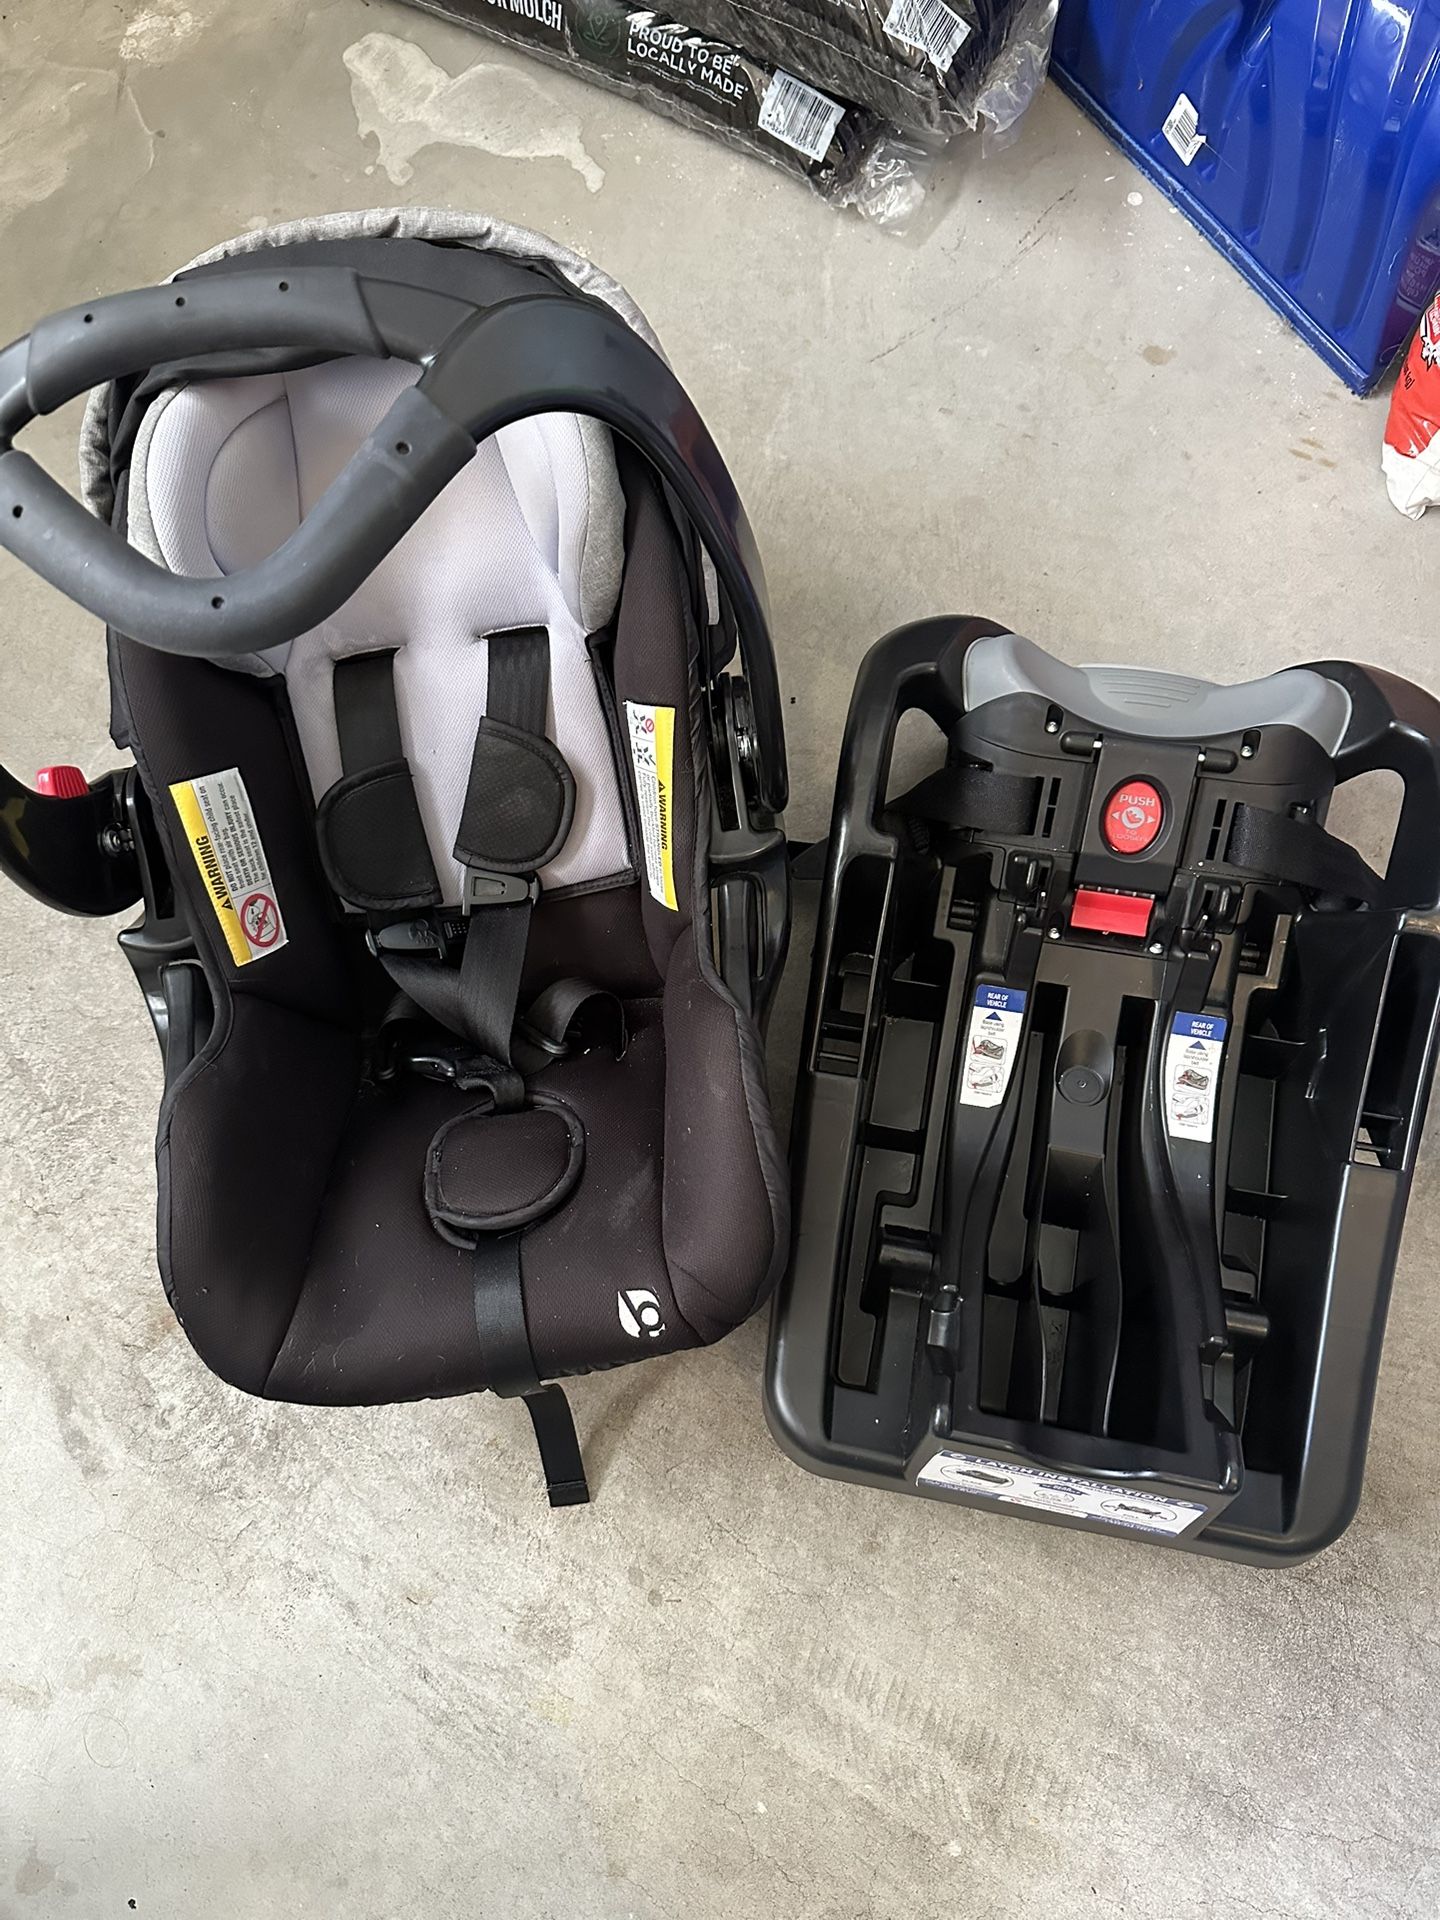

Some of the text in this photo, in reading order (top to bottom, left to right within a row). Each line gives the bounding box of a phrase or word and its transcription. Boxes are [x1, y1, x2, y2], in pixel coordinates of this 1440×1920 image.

[629, 21, 734, 75] PROUD TO BE
[627, 38, 697, 75] LOCALLY
[198, 785, 206, 793] on
[199, 794, 210, 807] seat
[1119, 794, 1155, 807] PUSH
[204, 807, 215, 822] child
[224, 810, 236, 832] INJURY
[658, 794, 668, 849] WARNING
[231, 832, 244, 857] SERIOUS
[195, 834, 228, 899] WARNING
[220, 853, 231, 870] place
[231, 861, 240, 875] seat
[239, 857, 247, 867] OR
[225, 869, 235, 882] NOT
[242, 866, 253, 885] DEATH
[229, 882, 238, 892] DO
[988, 992, 1001, 1000] REAR
[987, 999, 1007, 1008] VEHICLE
[1192, 1021, 1206, 1029] REAR
[1191, 1028, 1212, 1037] VEHICLE
[976, 1458, 1036, 1476] LATCH
[1039, 1472, 1168, 1503] INSTALLATION
